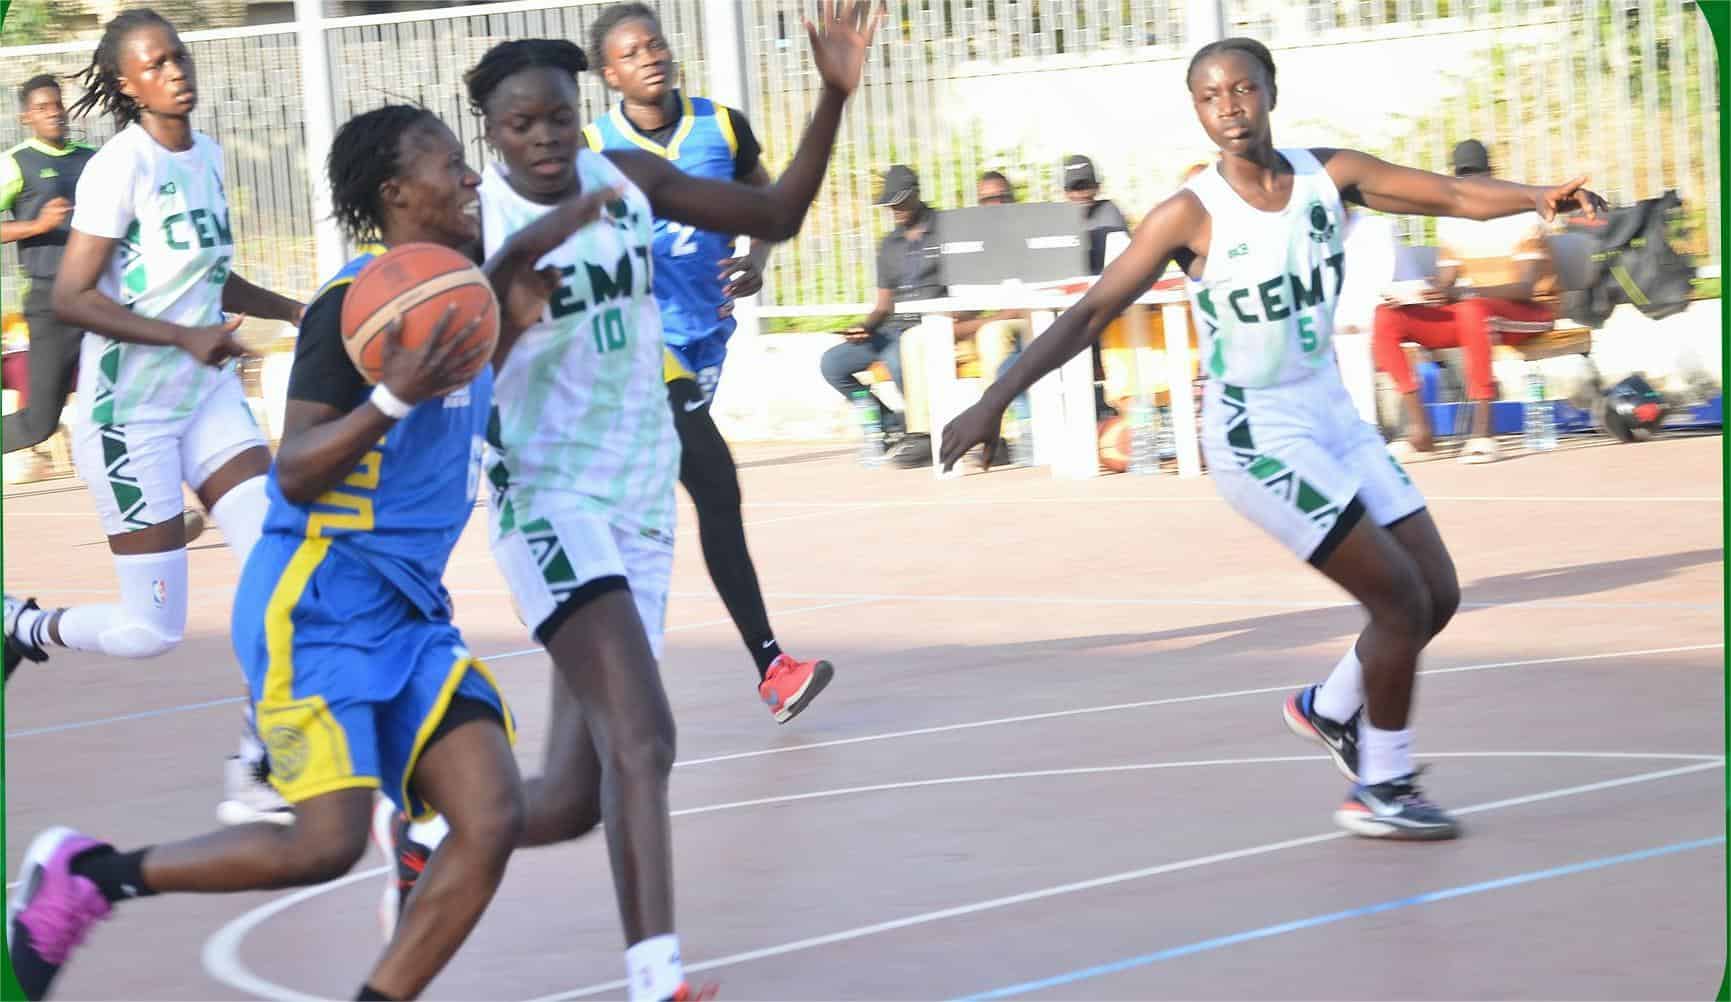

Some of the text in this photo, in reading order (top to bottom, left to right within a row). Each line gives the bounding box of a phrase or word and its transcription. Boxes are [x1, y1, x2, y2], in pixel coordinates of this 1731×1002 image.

[1228, 252, 1344, 324] CEMT
[592, 307, 626, 353] 10
[1298, 316, 1317, 352] 5
